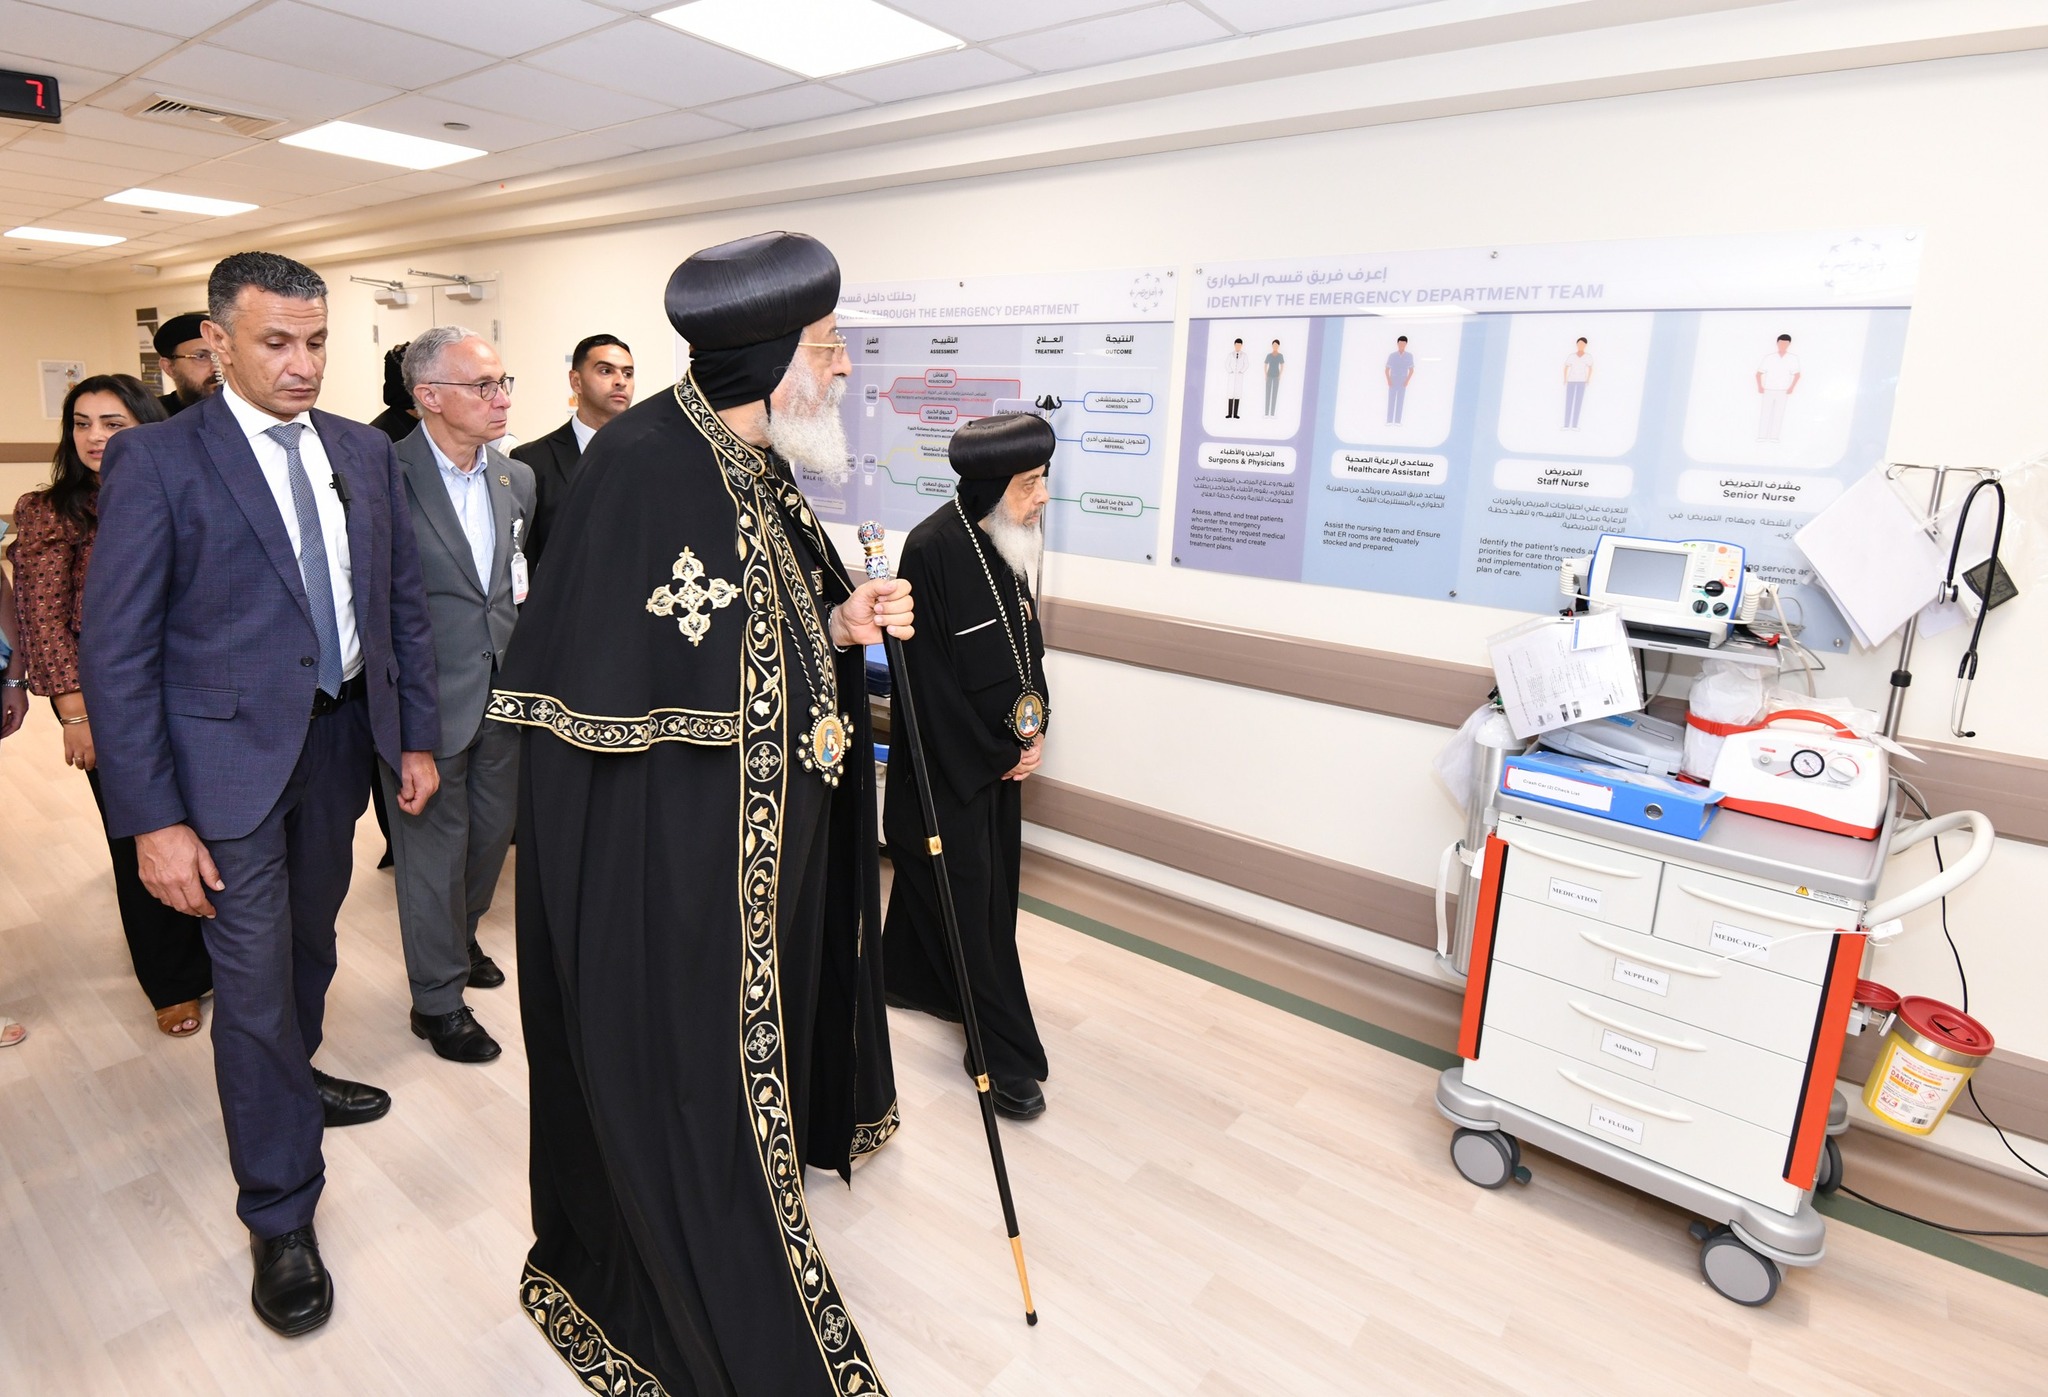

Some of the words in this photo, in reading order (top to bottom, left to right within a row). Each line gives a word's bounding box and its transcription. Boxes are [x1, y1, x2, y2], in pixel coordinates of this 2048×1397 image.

[1262, 270, 1303, 287] قسم
[1307, 268, 1343, 285] فريق
[1348, 266, 1387, 283] إعرف
[1206, 273, 1259, 289] الطوارئ
[838, 294, 861, 305] قسم
[863, 293, 885, 304] داخل
[887, 292, 916, 302] رحلتك
[1207, 294, 1273, 309] IDENTIFY
[1276, 293, 1305, 306] THE
[1309, 290, 1412, 306] EMERGENCY
[1417, 286, 1542, 303] DEPARTMENT
[1547, 284, 1604, 299] TEAM
[872, 309, 916, 319] THROUGH
[919, 308, 937, 318] THE
[939, 306, 1002, 318] EMERGENCY
[1004, 303, 1080, 317] DEPARTMENT
[866, 337, 879, 346] الفرز
[1106, 334, 1134, 344] النتيجة
[1246, 449, 1274, 457] الجراحين
[1208, 456, 1239, 465] Surgeons
[1248, 458, 1285, 467] Physicians
[1345, 455, 1373, 463] الصحية
[1374, 457, 1398, 466] الرعاية
[1348, 465, 1390, 474] Healthcare
[1392, 468, 1430, 477] Assistant
[1545, 468, 1582, 476] التمريض
[1537, 477, 1558, 486] Staff
[1561, 479, 1589, 488] Nurse
[1720, 479, 1763, 488] التمريض
[1765, 481, 1801, 491] مشرف
[1723, 489, 1759, 499] Senior
[1762, 493, 1795, 502] Nurse
[1192, 508, 1212, 516] Assess,
[1260, 515, 1283, 523] patients
[1229, 521, 1261, 529] emergency
[1324, 521, 1343, 529] Assist
[1357, 525, 1381, 534] nursing
[1417, 530, 1441, 538] Ensure
[1191, 525, 1222, 533] department.
[1262, 532, 1285, 540] medical
[1190, 540, 1215, 548] treatment
[1363, 543, 1394, 552] prepared.
[1382, 537, 1419, 547] adequately
[1480, 537, 1509, 547] Identify
[1510, 540, 1523, 548] the
[1561, 546, 1585, 555] needs
[1479, 547, 1511, 557] priorities
[1476, 565, 1492, 573] plan
[1494, 567, 1502, 575] of
[1494, 559, 1553, 570] implementation
[1761, 565, 1795, 575] service
[1523, 778, 1537, 787] Crash
[1554, 786, 1570, 794] Check
[1552, 887, 1598, 904] MEDICATION
[1623, 969, 1659, 985] SUPPLIES
[1615, 1042, 1643, 1057] AIRWAY
[1890, 1069, 1920, 1090] DANGER
[1609, 1118, 1635, 1133] FLUIDS
